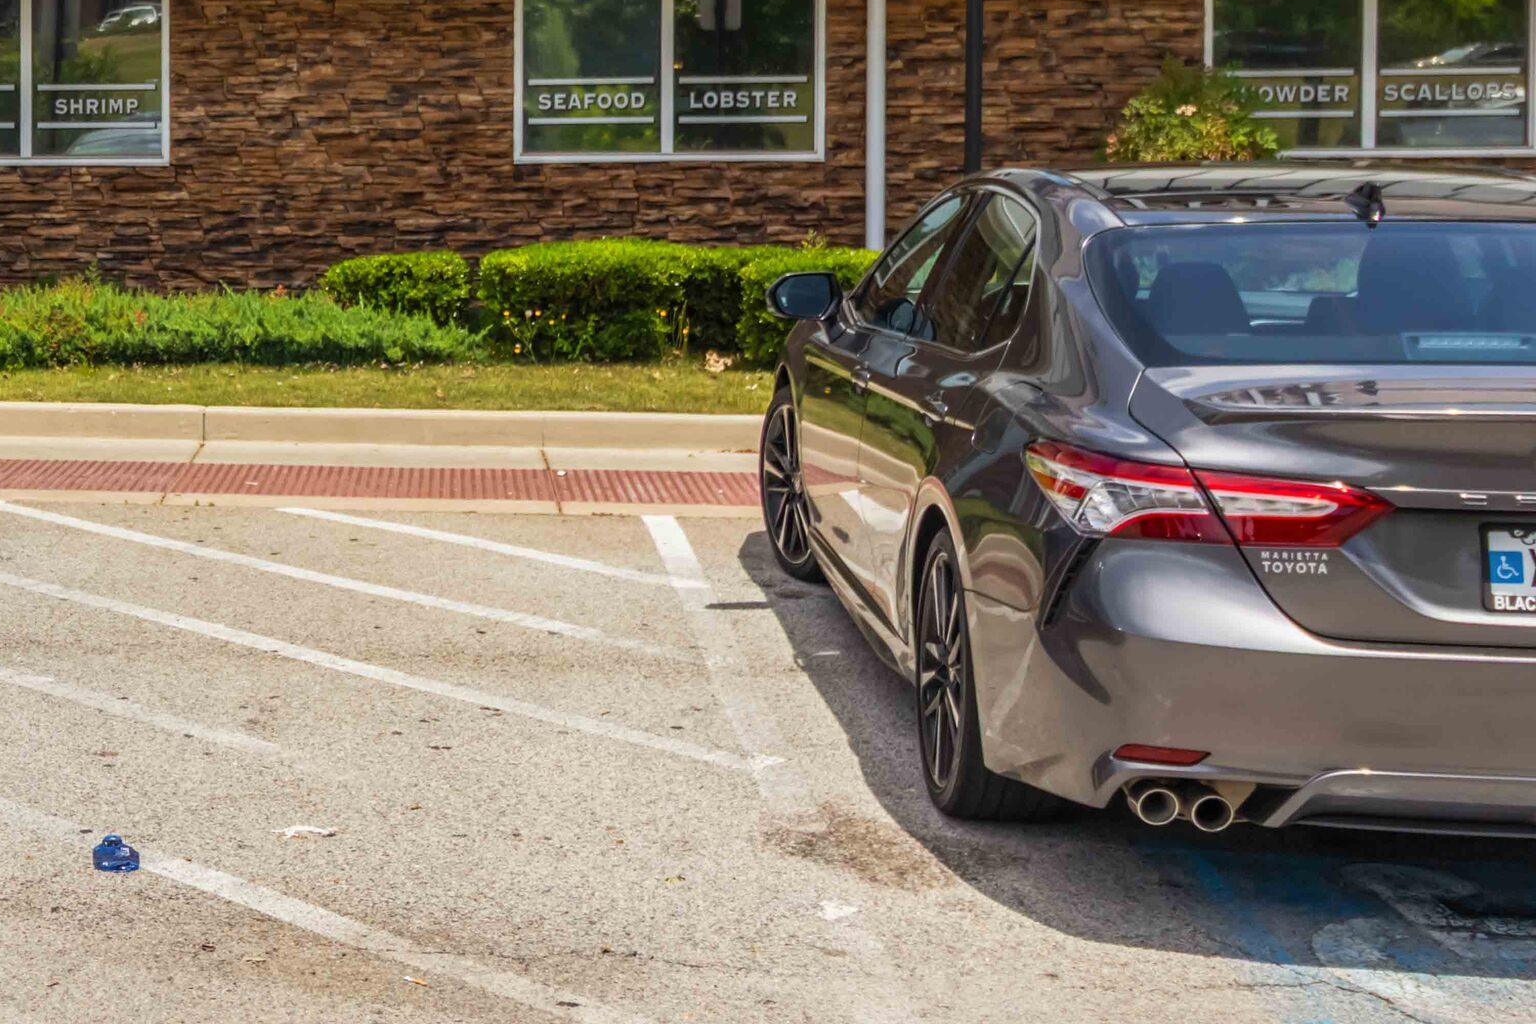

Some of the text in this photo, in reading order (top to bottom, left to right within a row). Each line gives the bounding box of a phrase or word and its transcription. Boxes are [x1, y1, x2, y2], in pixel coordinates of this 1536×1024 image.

[538, 92, 646, 110] SEAFOOD
[689, 91, 797, 109] LOBSTER
[1383, 83, 1515, 102] SCALLOPS
[54, 98, 139, 115] SHRIMP
[1261, 551, 1328, 561] MARIETTA
[1261, 561, 1328, 574] TOYOTA
